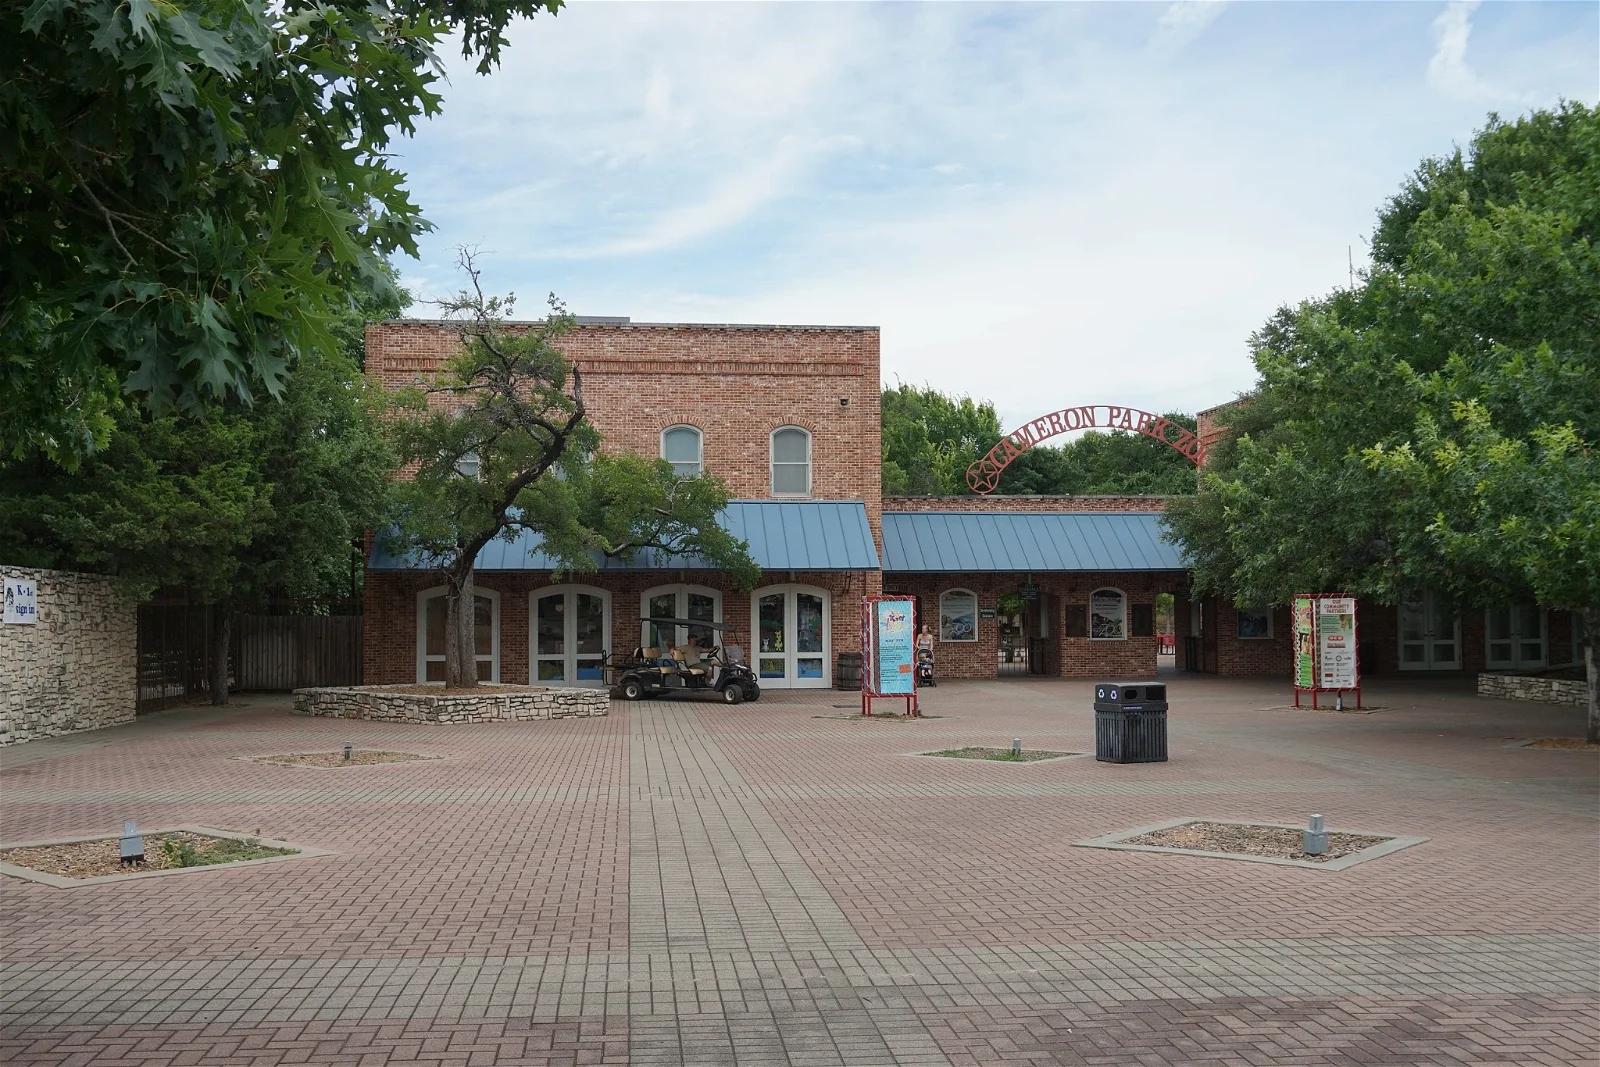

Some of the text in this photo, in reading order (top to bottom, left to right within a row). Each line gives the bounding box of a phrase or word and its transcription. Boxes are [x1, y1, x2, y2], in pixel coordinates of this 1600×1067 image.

[990, 406, 1096, 470] CAMERON
[1107, 406, 1171, 441] PARK
[17, 585, 23, 596] K
[16, 603, 35, 616] sign in
